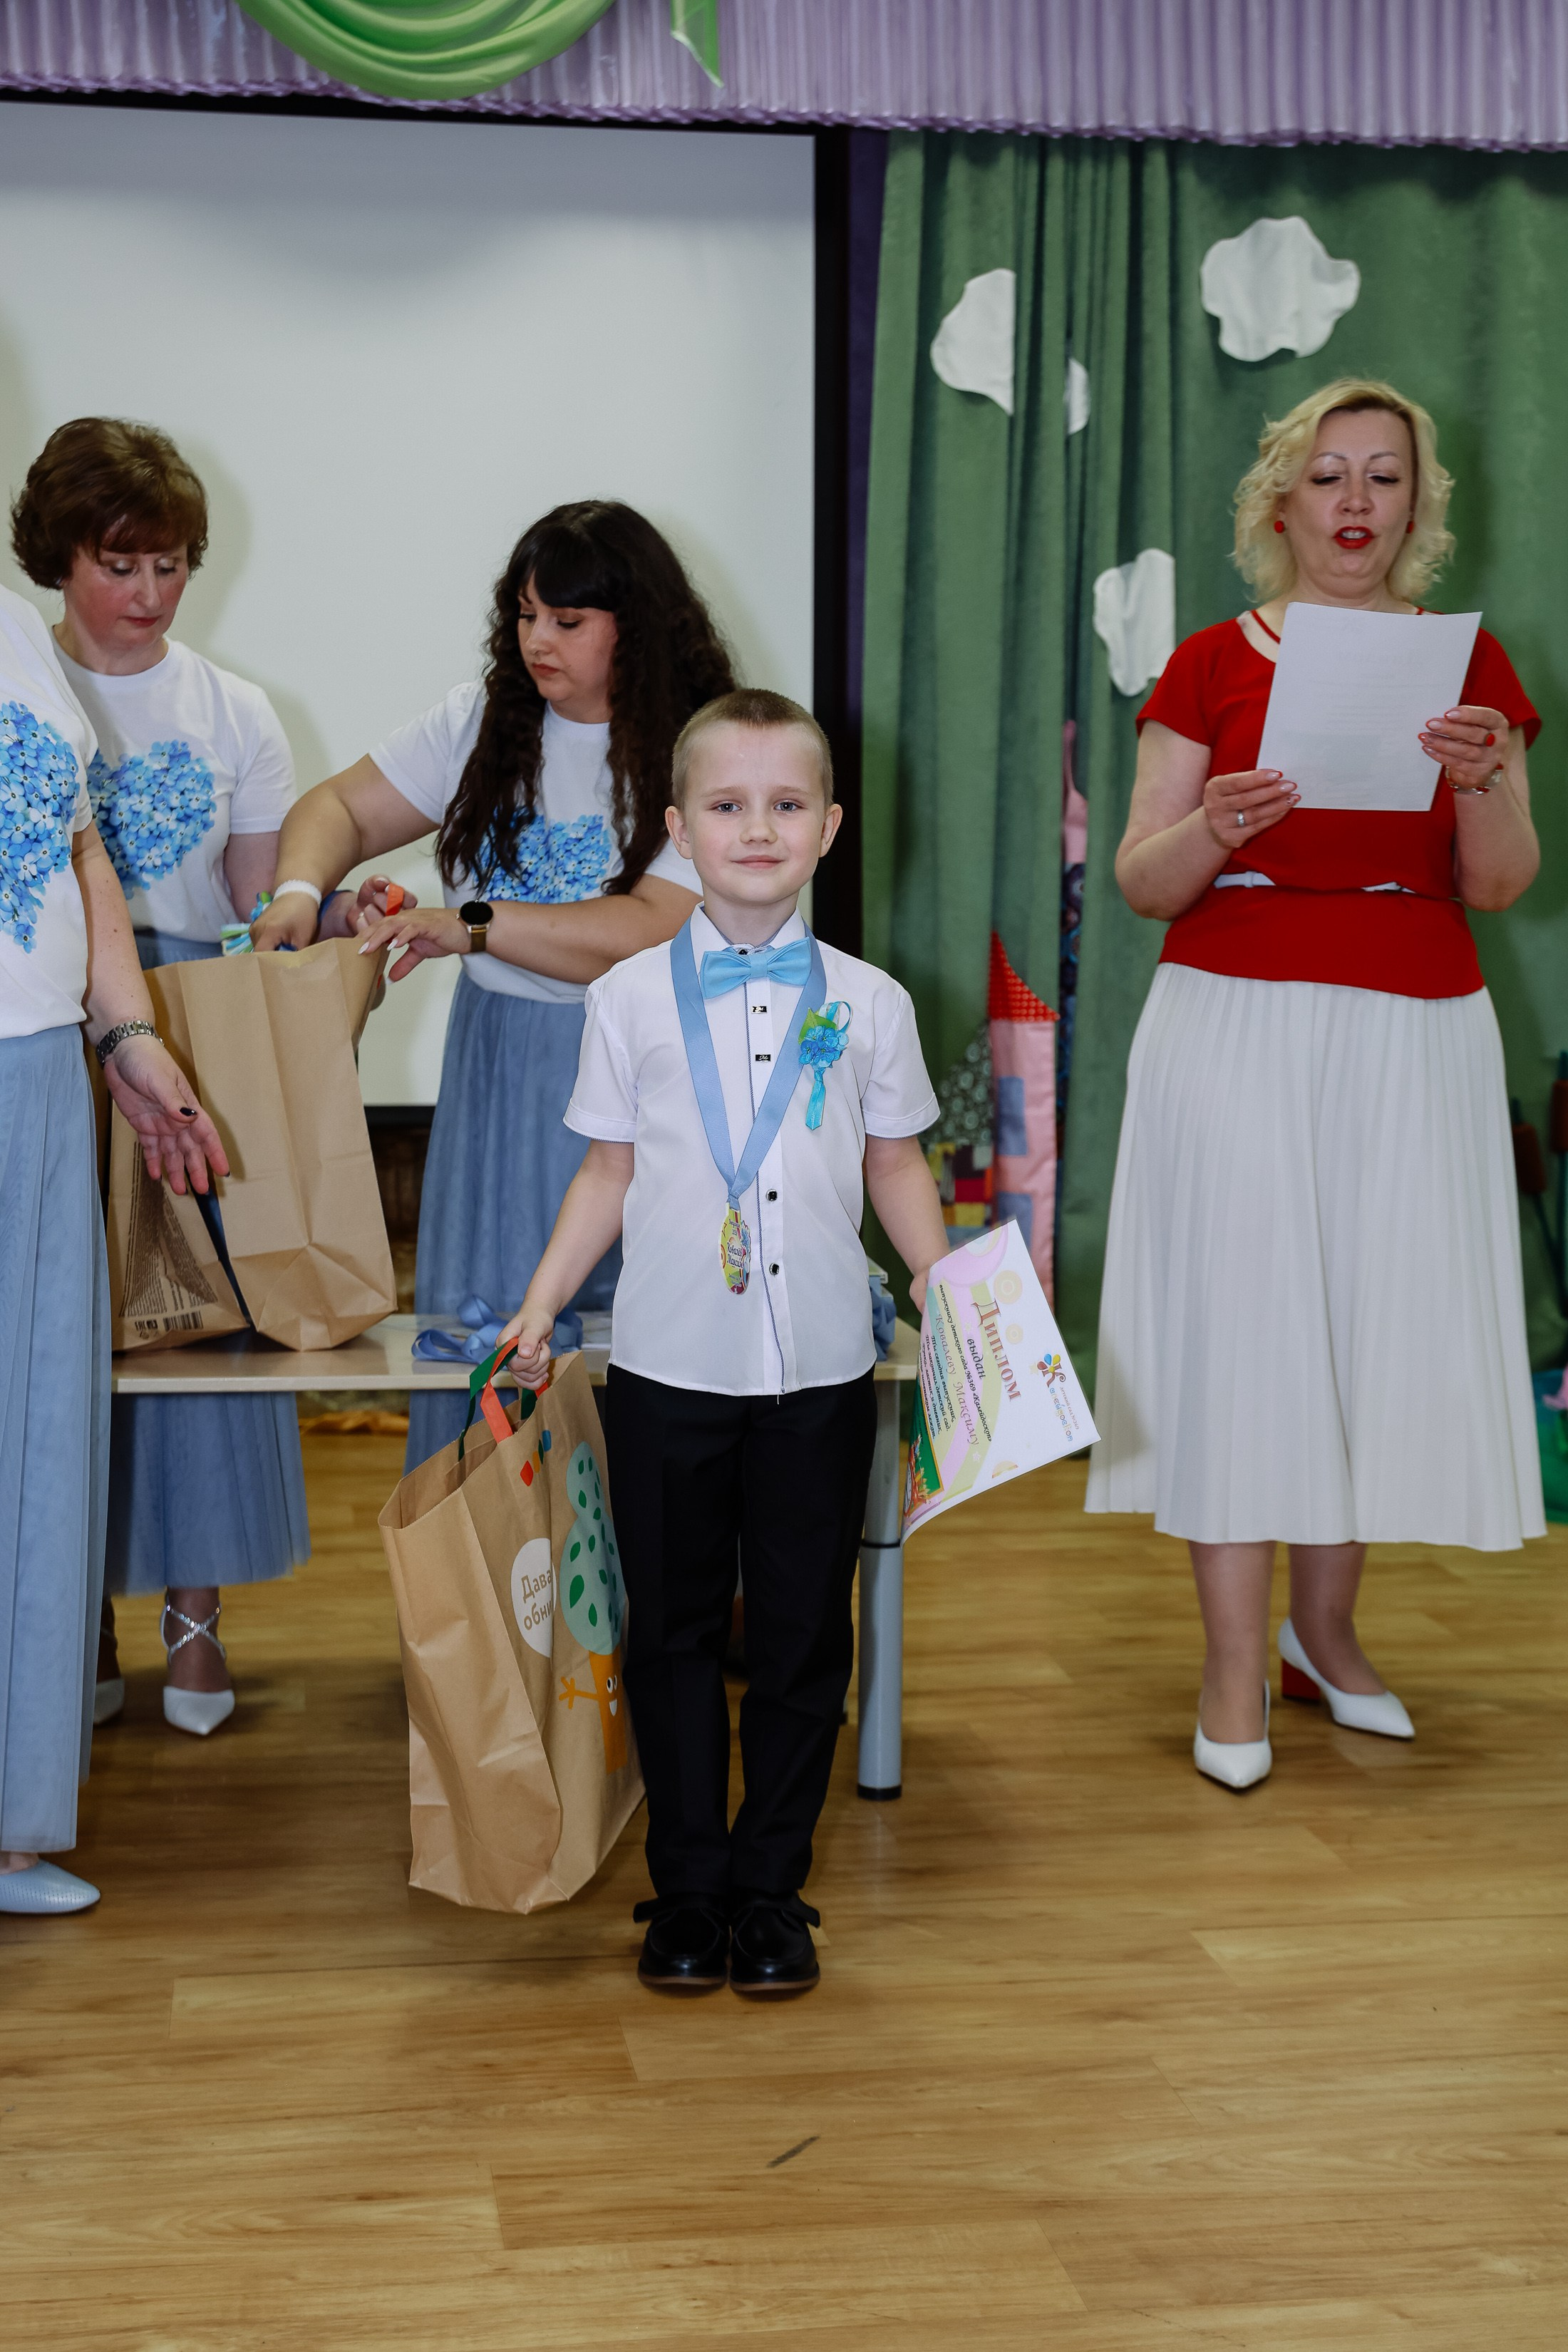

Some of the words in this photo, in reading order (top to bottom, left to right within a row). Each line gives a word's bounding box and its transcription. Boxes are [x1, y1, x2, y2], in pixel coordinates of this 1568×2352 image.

[931, 1335, 937, 1353] Ты
[934, 1353, 944, 1381] сегодня
[939, 1284, 953, 1324] выпускнику
[950, 1324, 963, 1355] детского
[959, 1355, 969, 1370] сада
[965, 1370, 976, 1392] №369
[966, 1338, 986, 1381] выдан
[971, 1298, 1021, 1403] Диплом
[925, 1334, 931, 1352] Ты
[928, 1352, 937, 1386] закончил
[935, 1385, 947, 1417] детский
[935, 1314, 956, 1375] Ковалеву
[953, 1381, 979, 1445] Максиму
[1060, 1386, 1070, 1406] детский
[1071, 1414, 1080, 1430] №369
[521, 1569, 552, 1604] Дава
[523, 1600, 553, 1631] обни
